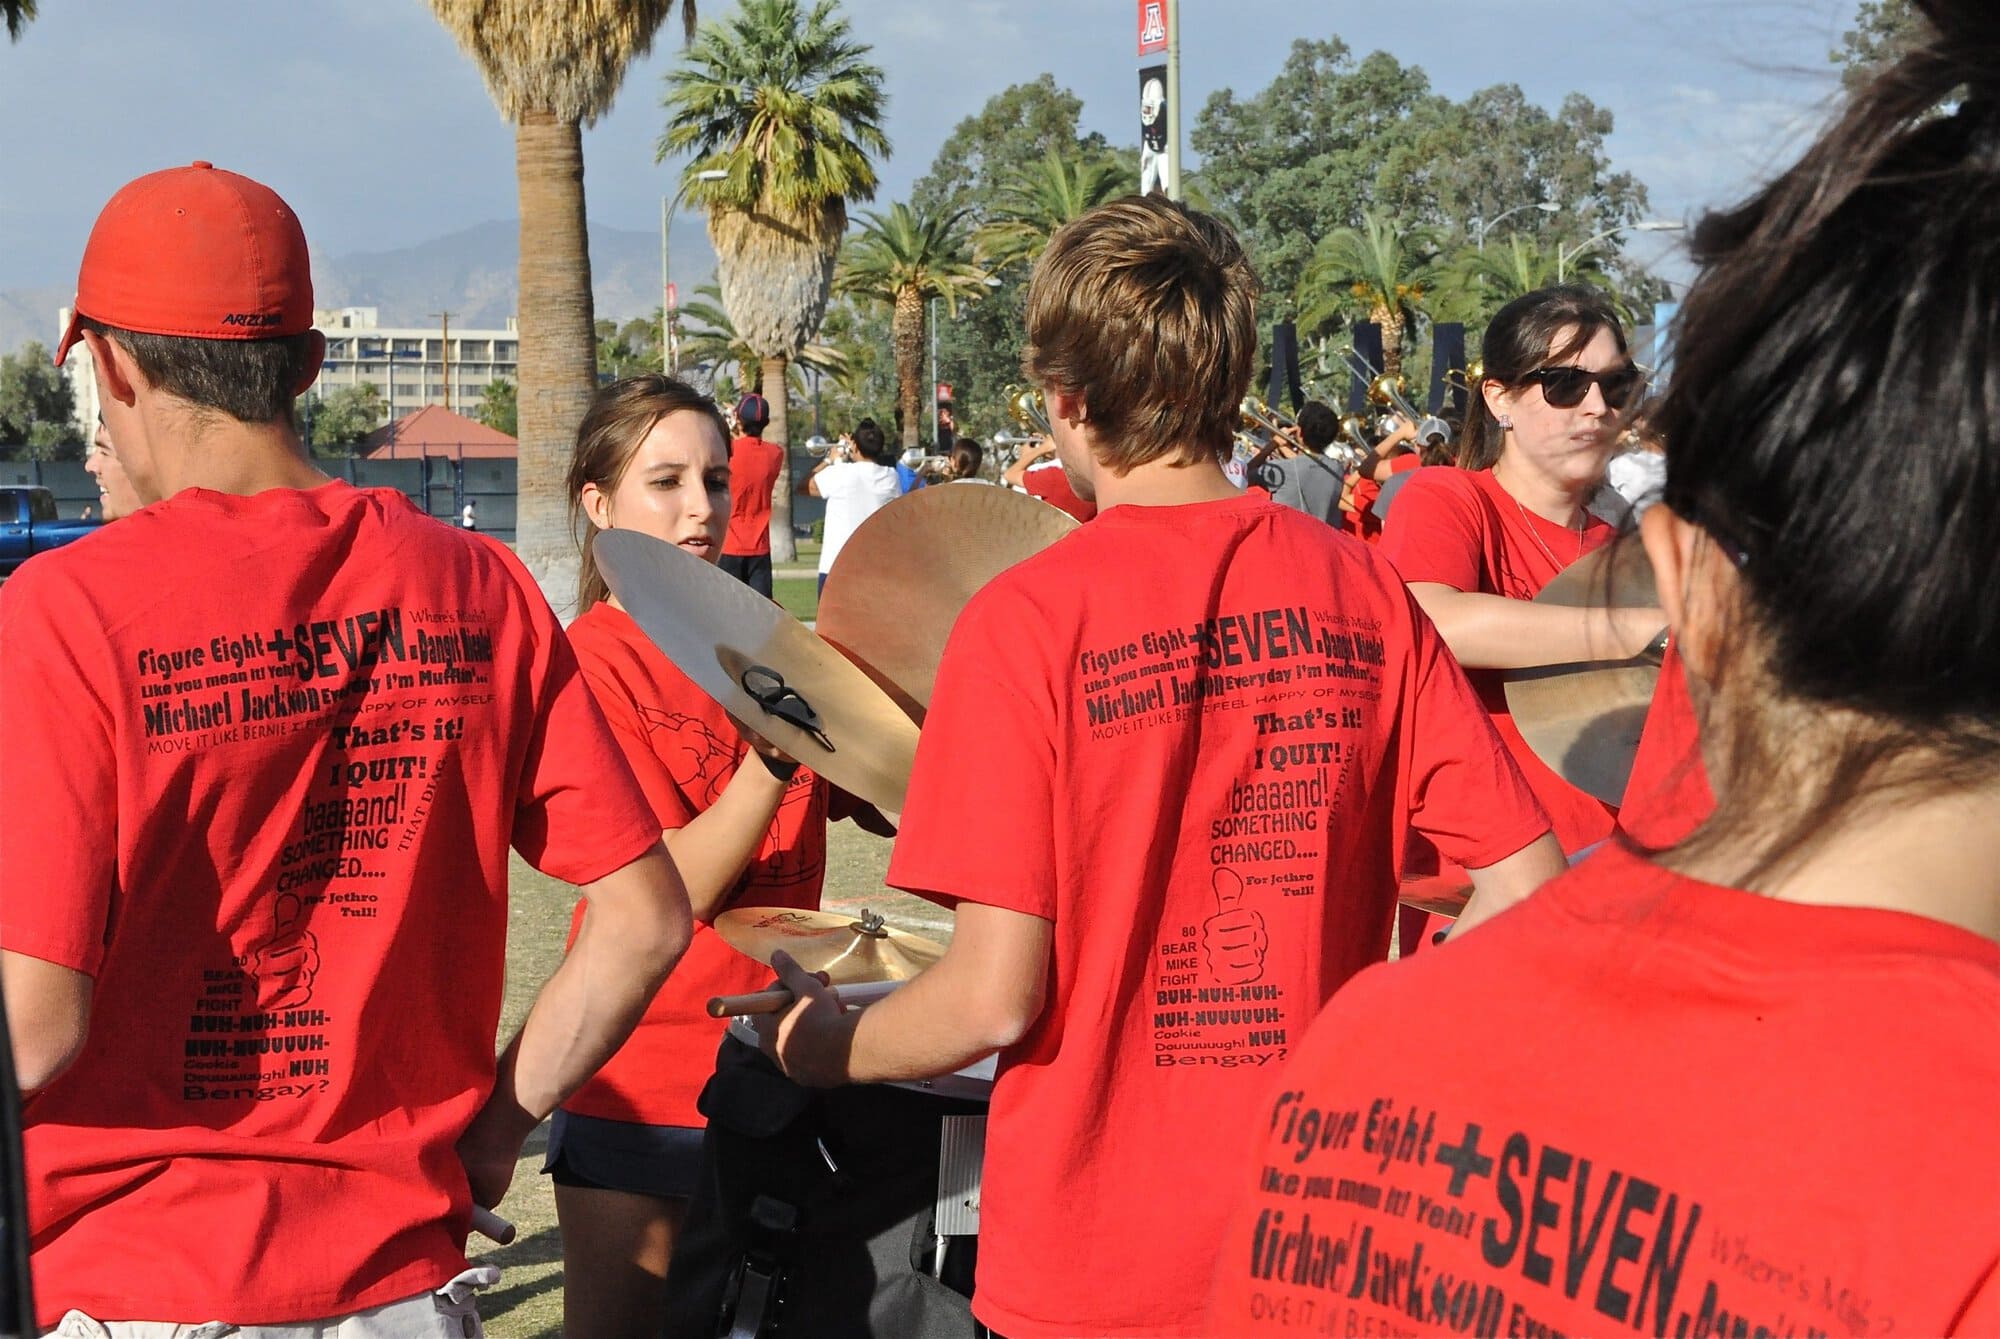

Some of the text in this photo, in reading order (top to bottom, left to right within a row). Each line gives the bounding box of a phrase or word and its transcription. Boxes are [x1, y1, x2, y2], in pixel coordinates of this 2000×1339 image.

[1142, 4, 1165, 43] A
[1312, 609, 1349, 627] Where's
[138, 647, 206, 681] Figure
[210, 632, 265, 668] Eight
[1080, 642, 1138, 676] Figure
[1142, 627, 1188, 659] Eight
[174, 678, 203, 695] you
[206, 671, 247, 687] mean
[386, 673, 414, 690] I'm
[1084, 678, 1111, 695] Like
[1113, 669, 1137, 687] you
[1140, 661, 1175, 678] mean
[1226, 667, 1291, 691] Everyday
[1296, 665, 1322, 680] I'm
[143, 684, 321, 738] Michael Jackson
[402, 698, 427, 710] OF
[434, 694, 496, 707] MYSELF
[1086, 679, 1165, 728] Michael
[1171, 674, 1225, 706] Jacon
[1212, 700, 1249, 713] FEEL
[1256, 690, 1307, 705] HAPPY
[1313, 687, 1336, 698] OF
[332, 717, 465, 750] That's it!
[1091, 721, 1129, 742] MOVE
[1133, 718, 1145, 732] IT
[1149, 711, 1172, 727] LIKE
[1253, 707, 1363, 736] That's it!
[148, 722, 287, 755] MOVE IT LIKE BERNIE
[1255, 742, 1341, 773] I QUIT!
[330, 756, 427, 789] I QUIT!
[1231, 767, 1329, 814] baaaand!
[397, 806, 425, 852] THAT
[1211, 810, 1317, 840] SOMETHING
[280, 828, 389, 867] SOMETHING
[1246, 872, 1314, 886] For Jethro
[1282, 886, 1315, 897] Tull!
[329, 892, 378, 905] Jethro
[340, 907, 377, 918] Tull!
[1182, 926, 1197, 938] 80
[1161, 942, 1197, 956] BEAR
[1166, 957, 1198, 971] MIKE
[1160, 973, 1198, 987] FIGHT
[196, 999, 241, 1011] FIGHT
[1154, 1028, 1201, 1040] Cookie
[1249, 1029, 1286, 1047] NUH
[289, 1059, 329, 1078] NUH
[1155, 1047, 1288, 1068] Bengay?
[184, 1079, 330, 1101] Bengay?
[1416, 1194, 1477, 1240] Yeh!
[1347, 1225, 1505, 1339] Jackson
[1250, 1293, 1290, 1326] OVE
